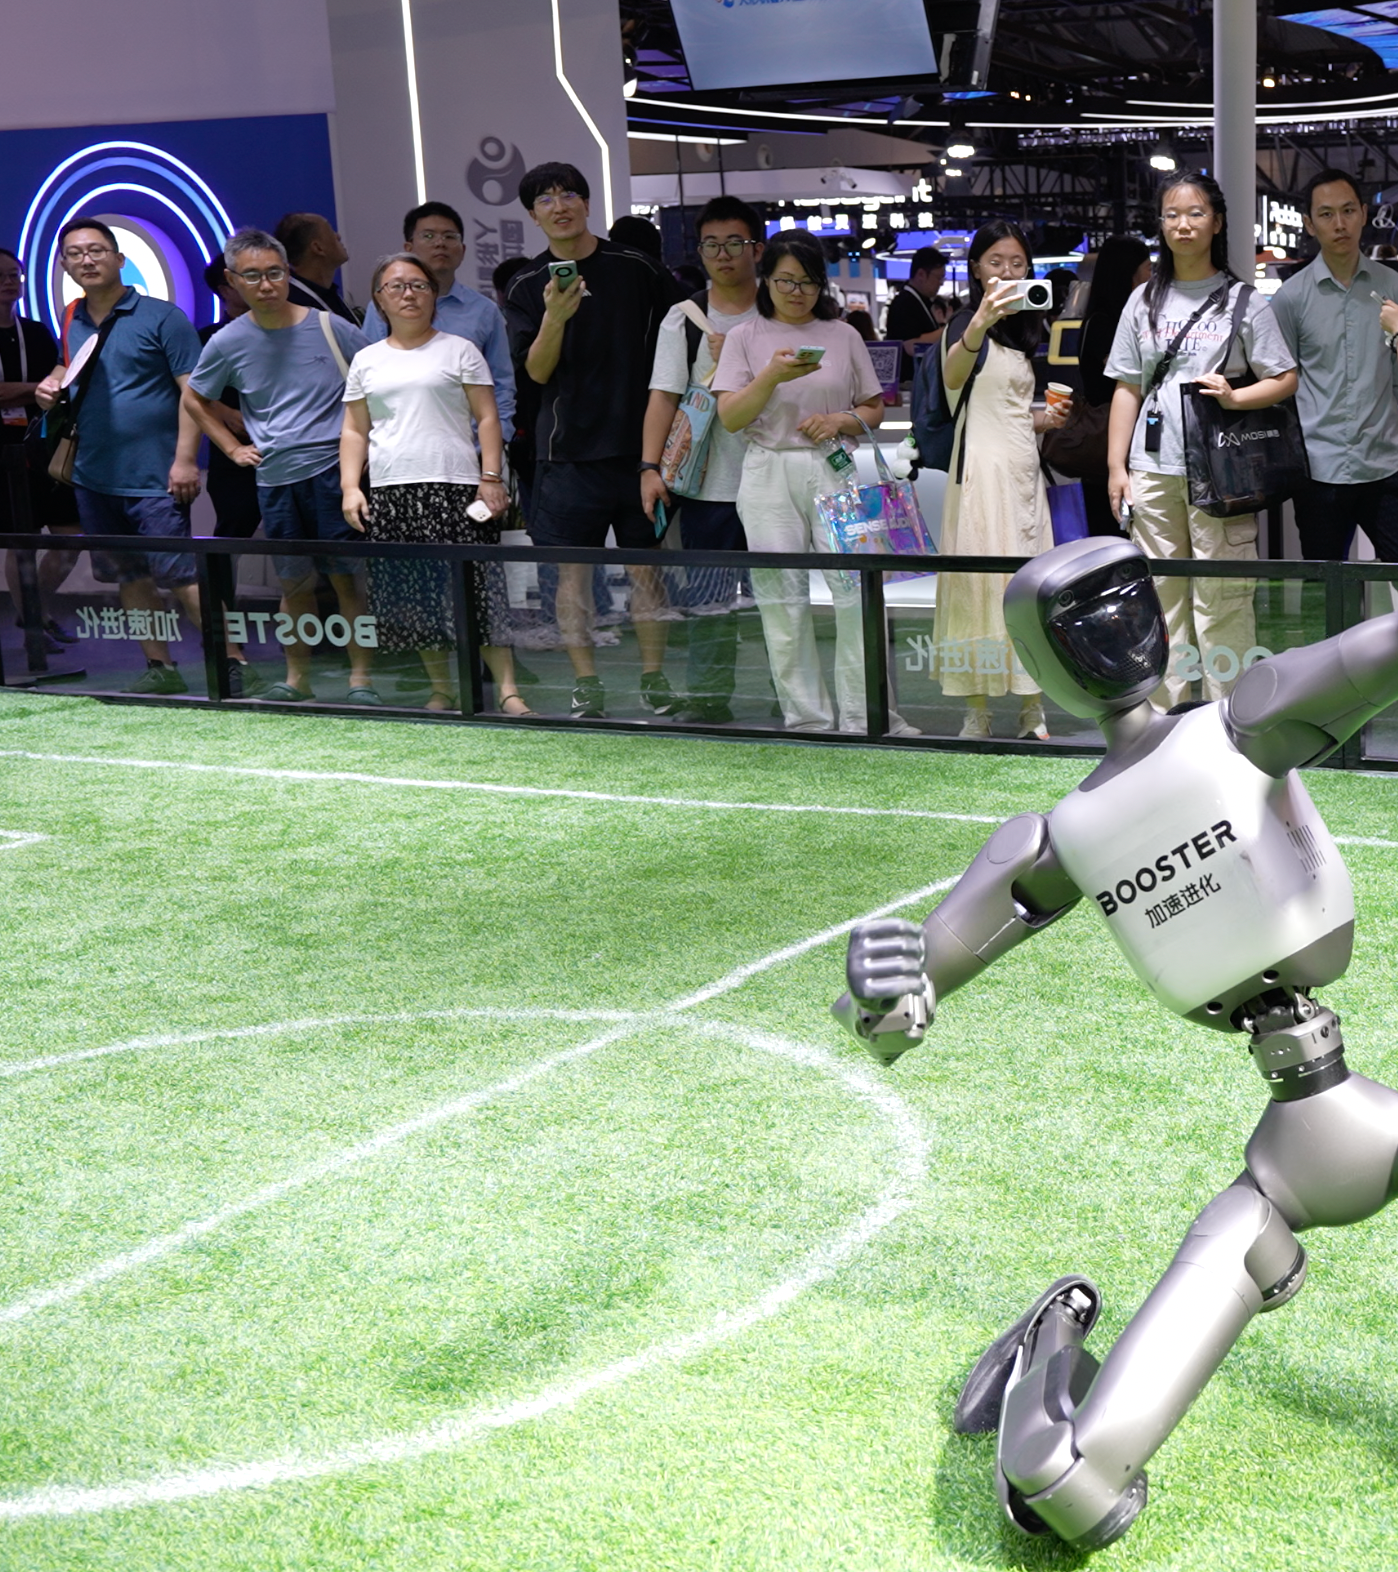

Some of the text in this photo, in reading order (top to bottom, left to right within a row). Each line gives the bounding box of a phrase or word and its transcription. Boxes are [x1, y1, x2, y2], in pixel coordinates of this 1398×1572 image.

[1095, 819, 1238, 917] BOOSTER
[1144, 873, 1222, 929] 加速进化
